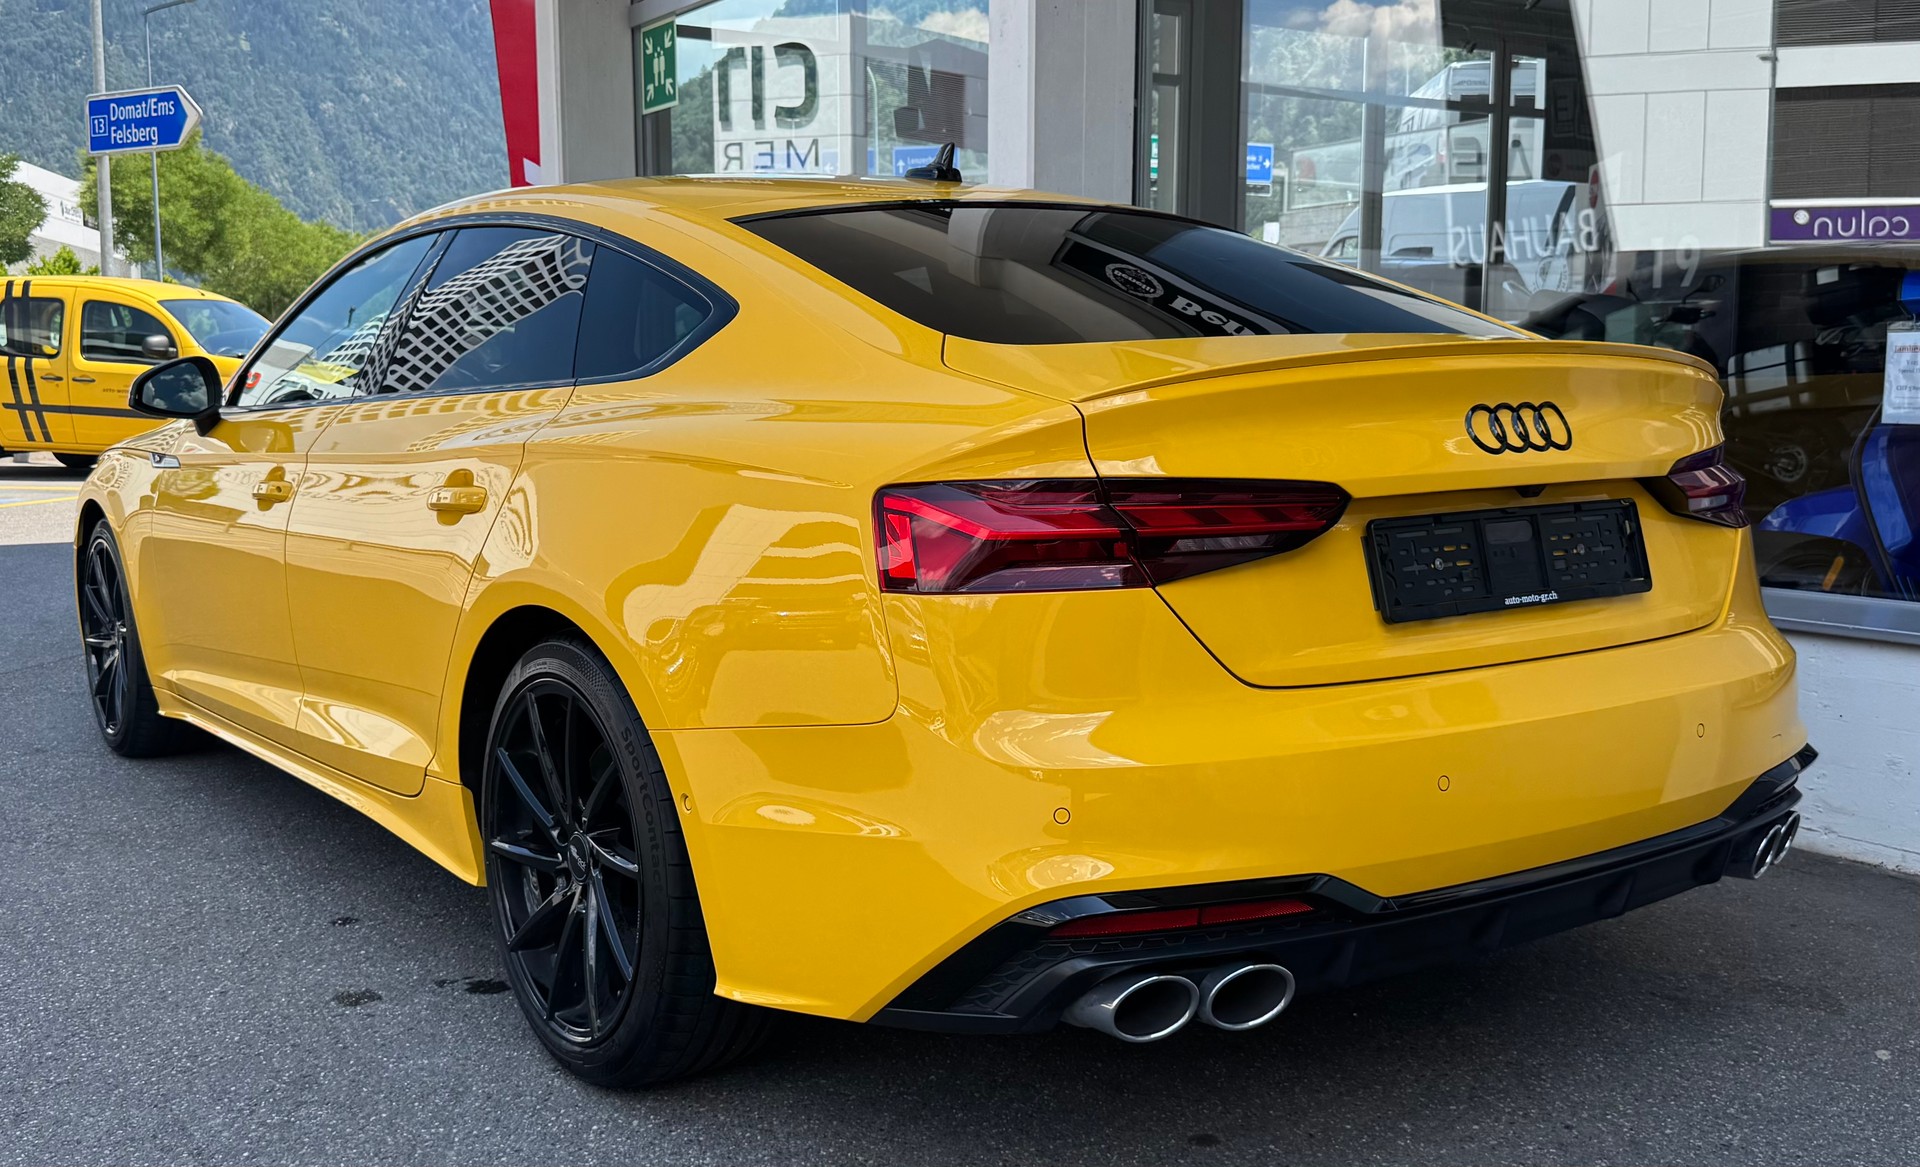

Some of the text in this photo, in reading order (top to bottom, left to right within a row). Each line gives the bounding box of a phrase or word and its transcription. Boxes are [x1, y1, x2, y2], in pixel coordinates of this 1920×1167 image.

[110, 98, 175, 121] Domat/Ems
[94, 118, 105, 134] 13
[111, 123, 158, 145] Felsberg
[1505, 590, 1558, 605] auto-moto-gr.ch
